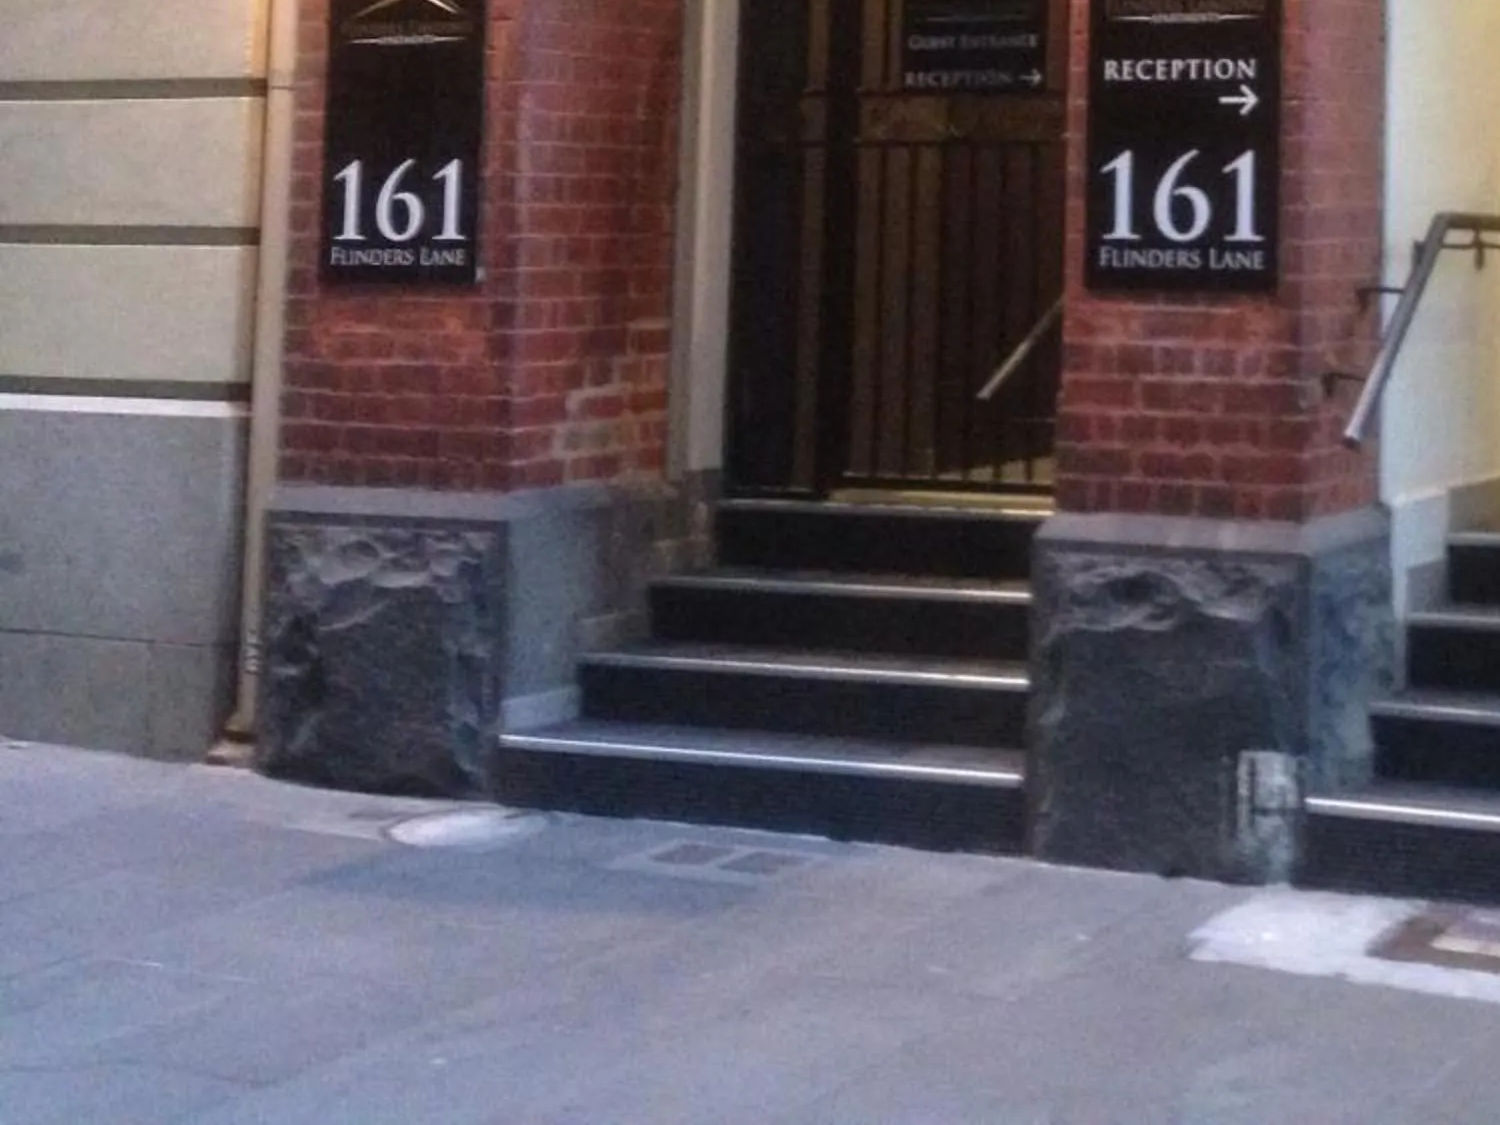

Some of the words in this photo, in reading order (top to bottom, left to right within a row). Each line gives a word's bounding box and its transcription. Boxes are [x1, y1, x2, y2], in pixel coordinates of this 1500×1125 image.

[1103, 58, 1257, 81] RECEPTION
[333, 158, 467, 242] 161
[1100, 149, 1265, 242] 161
[331, 246, 415, 266] FLINDERS
[419, 246, 466, 266] LANE
[1100, 245, 1201, 268] FLINDERS
[1208, 248, 1265, 270] LANE
